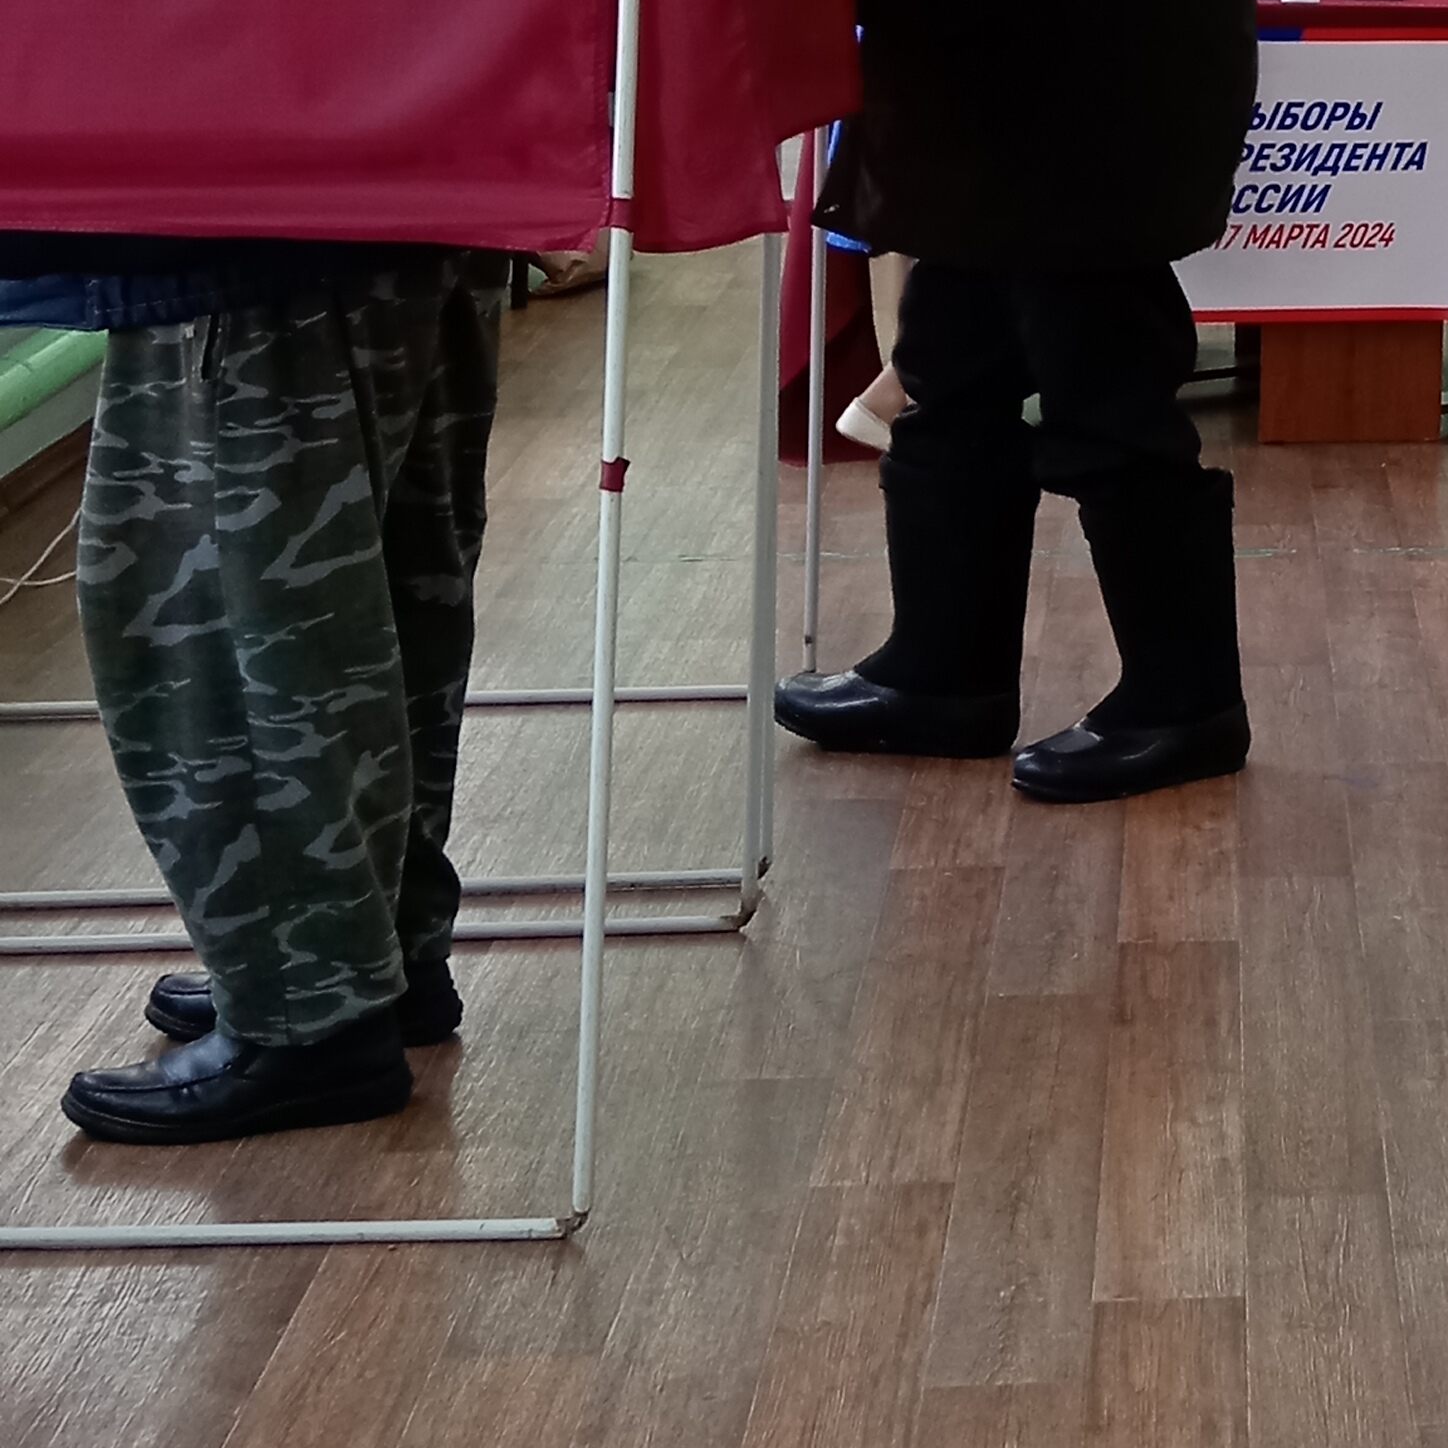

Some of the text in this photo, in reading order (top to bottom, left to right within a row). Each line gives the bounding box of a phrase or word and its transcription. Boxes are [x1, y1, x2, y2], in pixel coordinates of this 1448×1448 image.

[1248, 101, 1384, 131] ЫБОРЫ
[1241, 142, 1428, 177] РЕЗИДЕНТА
[1232, 183, 1332, 214] ССИИ
[1243, 223, 1331, 249] МАРТА
[1333, 222, 1396, 248] 2024
